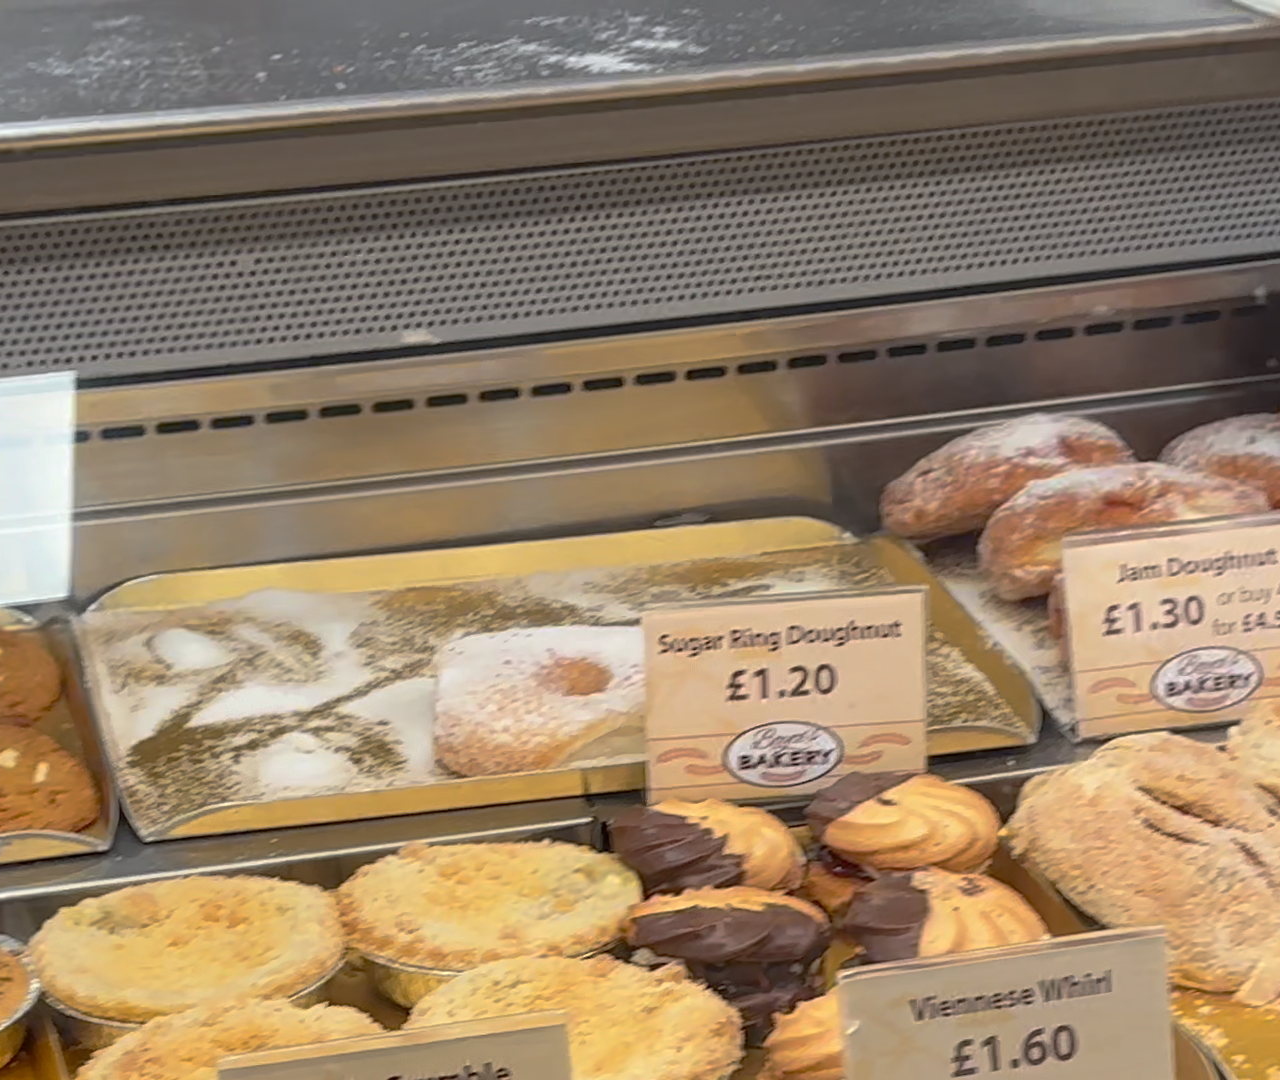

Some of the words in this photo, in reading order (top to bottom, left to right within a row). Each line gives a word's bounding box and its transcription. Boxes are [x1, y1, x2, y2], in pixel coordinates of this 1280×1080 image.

[1116, 563, 1163, 584] Jam
[1166, 548, 1279, 578] Doughnut
[1216, 591, 1237, 606] or
[1239, 586, 1274, 606] buy
[1101, 594, 1206, 637] £1.30
[1211, 617, 1238, 636] for
[657, 634, 724, 658] Sugar
[729, 627, 782, 652] Ring
[785, 619, 903, 647] Doughnut
[725, 662, 840, 703] £1.20
[1164, 671, 1256, 697] BAKERY
[737, 747, 836, 771] BAKERY
[908, 985, 1035, 1023] Viennese
[1036, 968, 1113, 1005] Whirl
[950, 1023, 1080, 1079] £1.60
